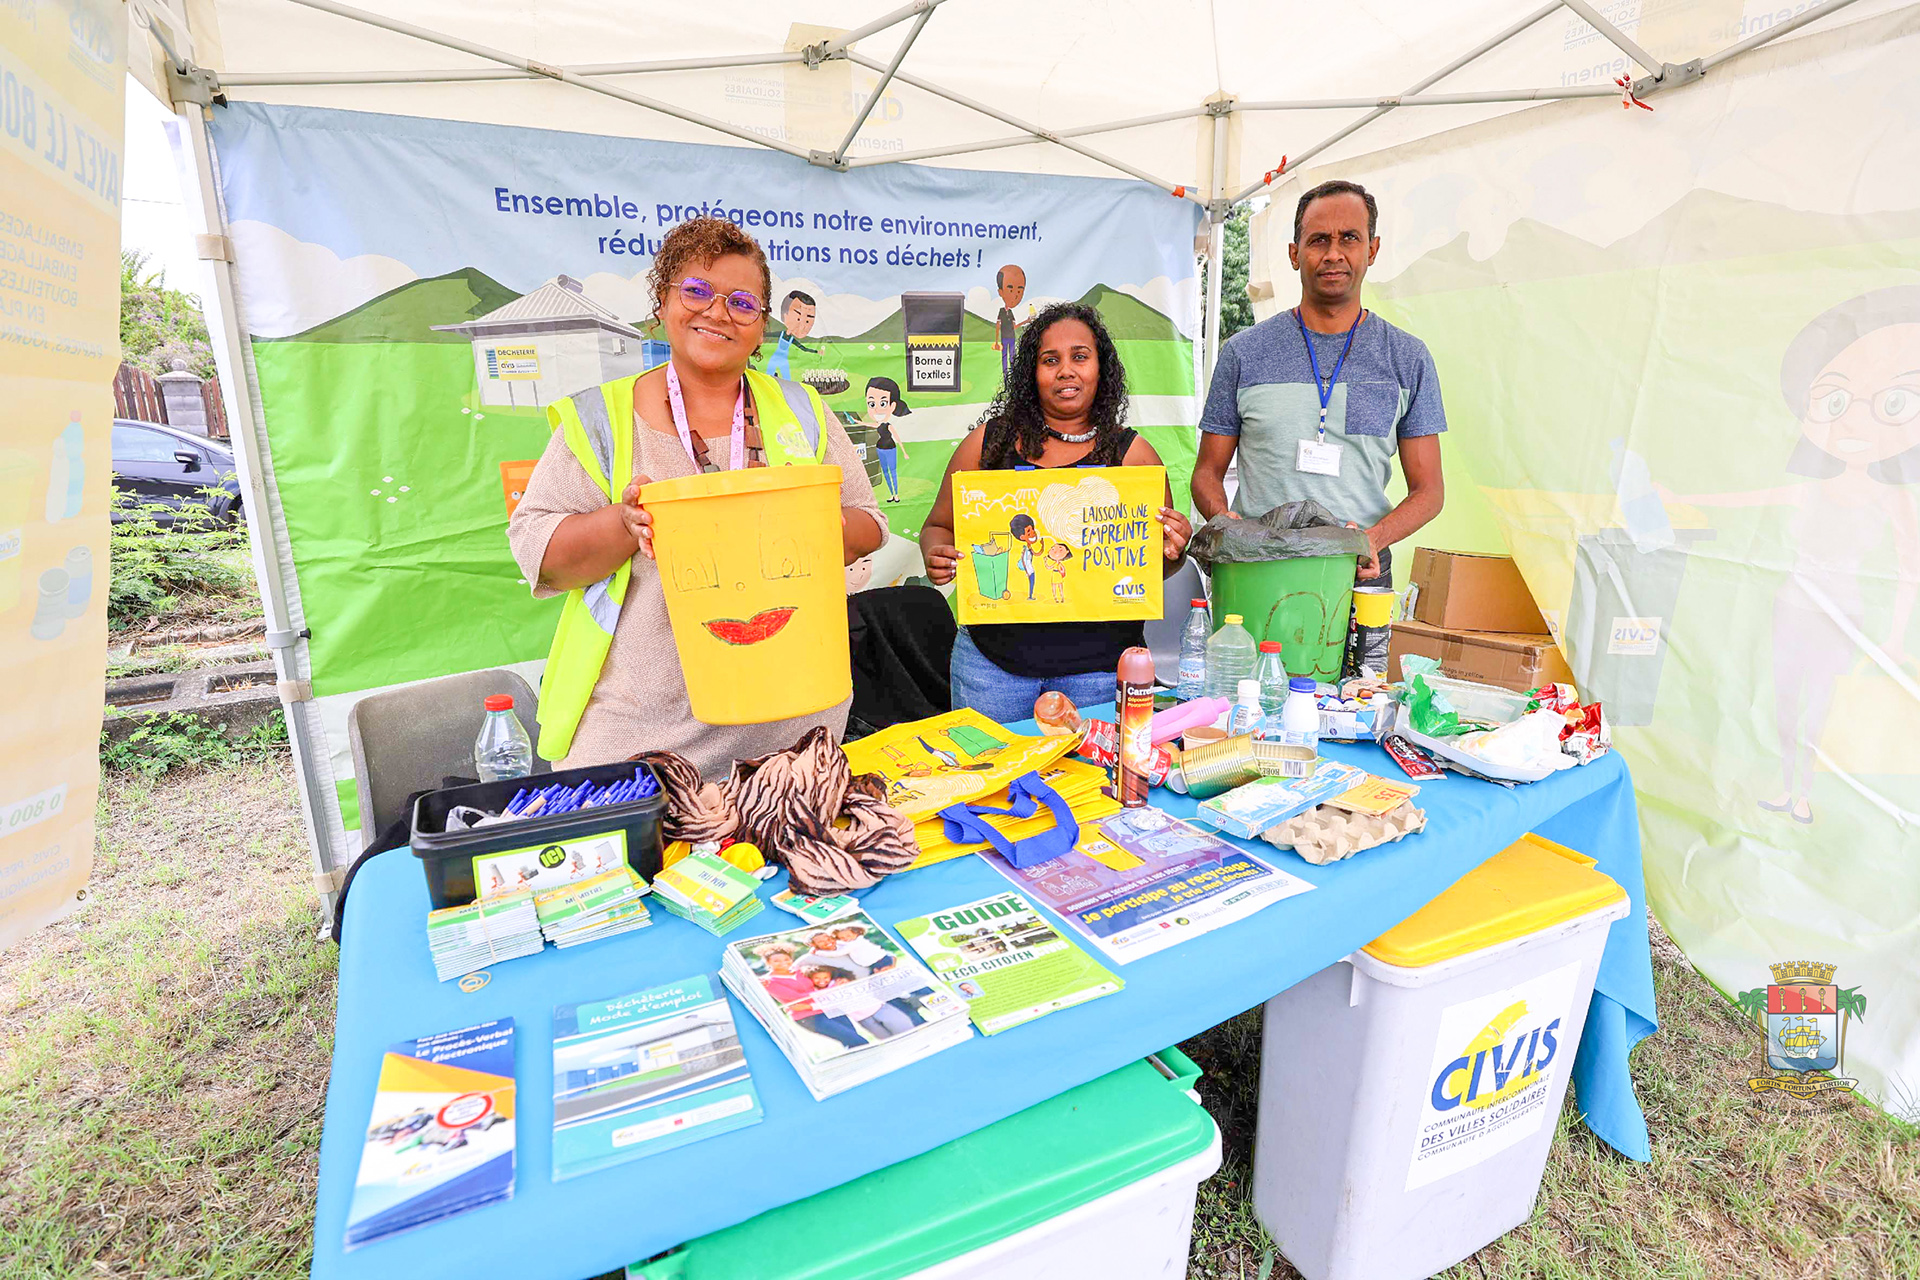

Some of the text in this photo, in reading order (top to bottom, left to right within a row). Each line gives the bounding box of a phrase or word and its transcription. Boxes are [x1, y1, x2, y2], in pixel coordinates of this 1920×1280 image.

[494, 186, 1042, 243] Ensemble, protégeons notre environnement,
[598, 228, 984, 269] rédu trions nos déchets !
[914, 354, 953, 366] Borne à
[915, 369, 952, 380] Textiles
[1082, 502, 1149, 523] LAISSONS UNE
[1081, 519, 1150, 547] EMPREINTE
[1082, 545, 1148, 572] POSITIVE
[1112, 583, 1146, 596] CIVIS
[540, 846, 565, 869] ICI
[1081, 912, 1102, 924] Je
[1100, 888, 1169, 919] participe
[1167, 880, 1189, 894] au
[1186, 861, 1256, 887] recyclage,
[1170, 893, 1185, 905] je
[1181, 887, 1204, 900] trie
[1201, 879, 1224, 892] mes
[1221, 868, 1260, 884] déchets
[932, 896, 1028, 931] GUIDE
[589, 991, 703, 1026] Mode d'emploi
[415, 1027, 514, 1058] Le Procès-Verbal
[431, 1038, 509, 1064] électronique
[1431, 1017, 1561, 1112] CIVIS
[1421, 1084, 1548, 1149] DES VILLES SOLIDAIRES
[1424, 1073, 1550, 1134] COMMUNAUTE INTERCOMMUNALE
[1417, 1133, 1476, 1162] COMMUNAUTE
